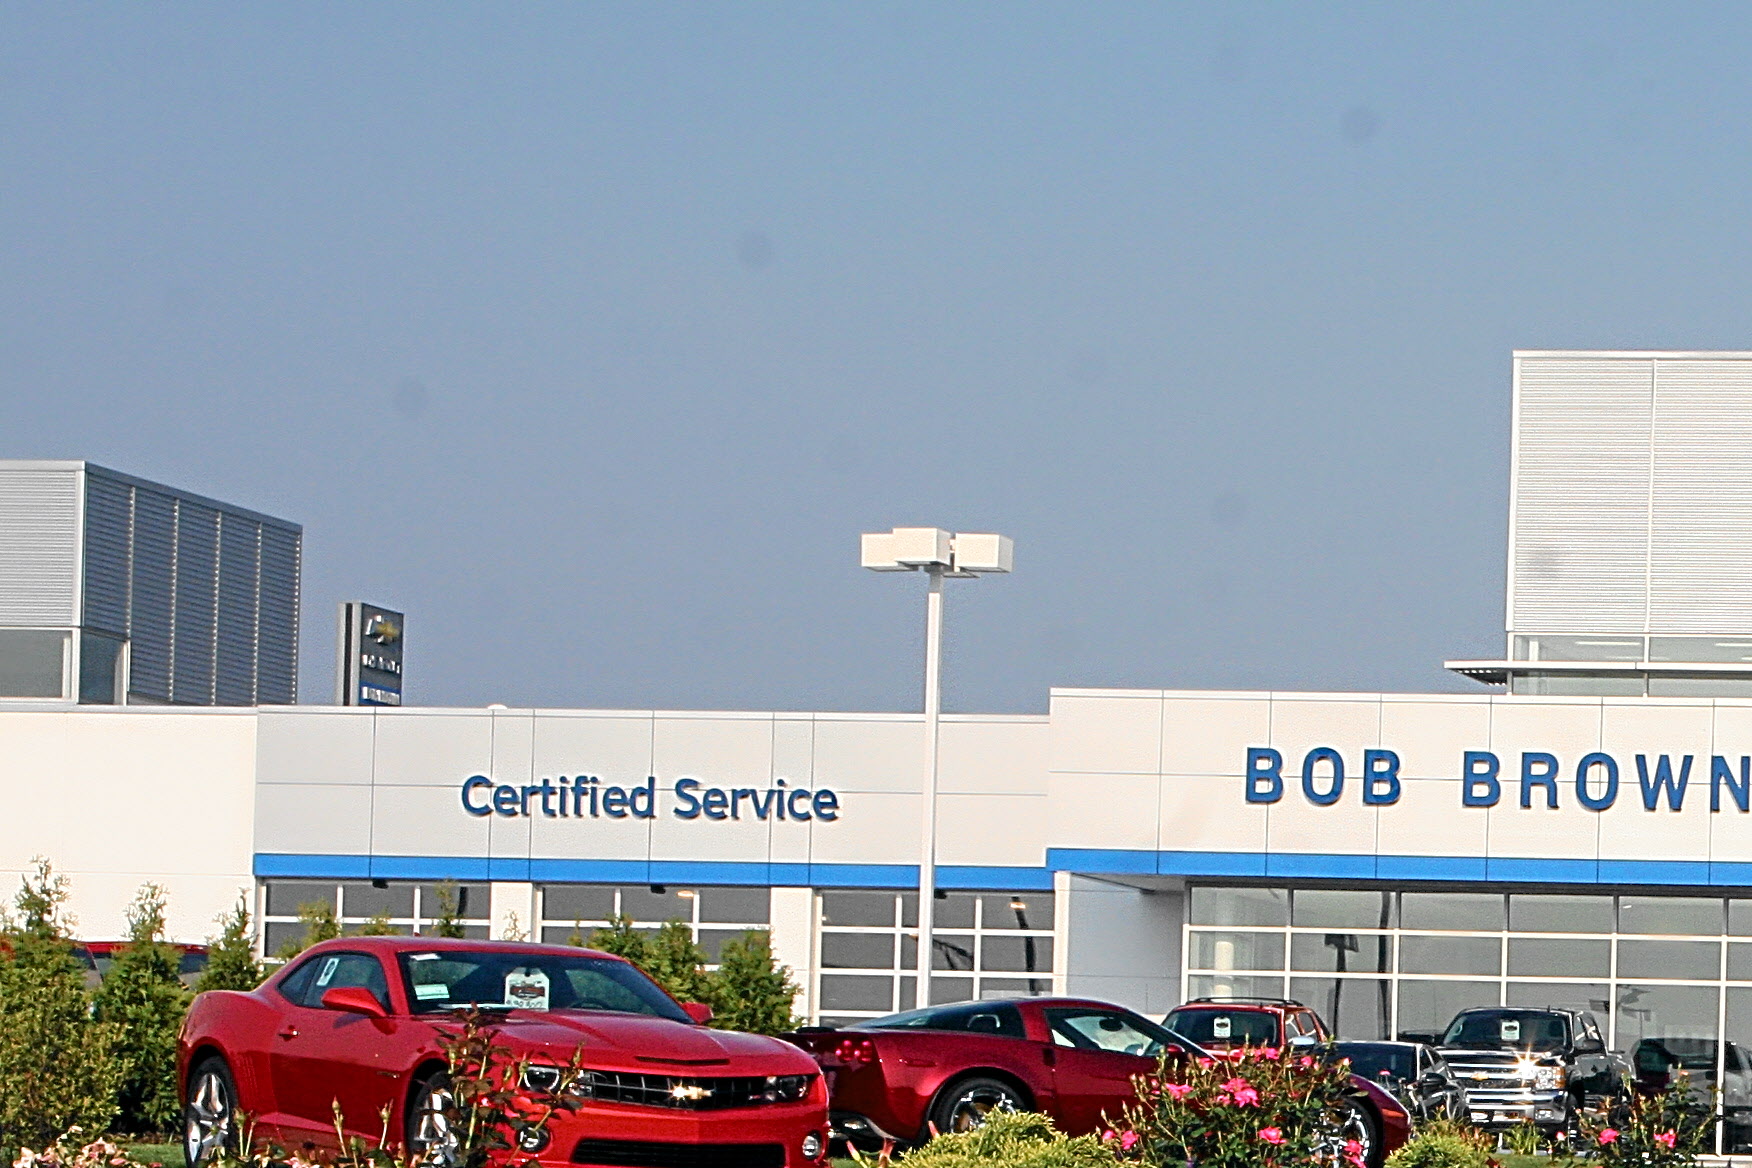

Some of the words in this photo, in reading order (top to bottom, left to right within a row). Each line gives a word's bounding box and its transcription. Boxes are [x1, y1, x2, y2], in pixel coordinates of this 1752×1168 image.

[461, 774, 657, 819] Certified
[673, 778, 840, 822] Service
[1246, 746, 1402, 806] BOB
[1462, 750, 1751, 813] BROWN
